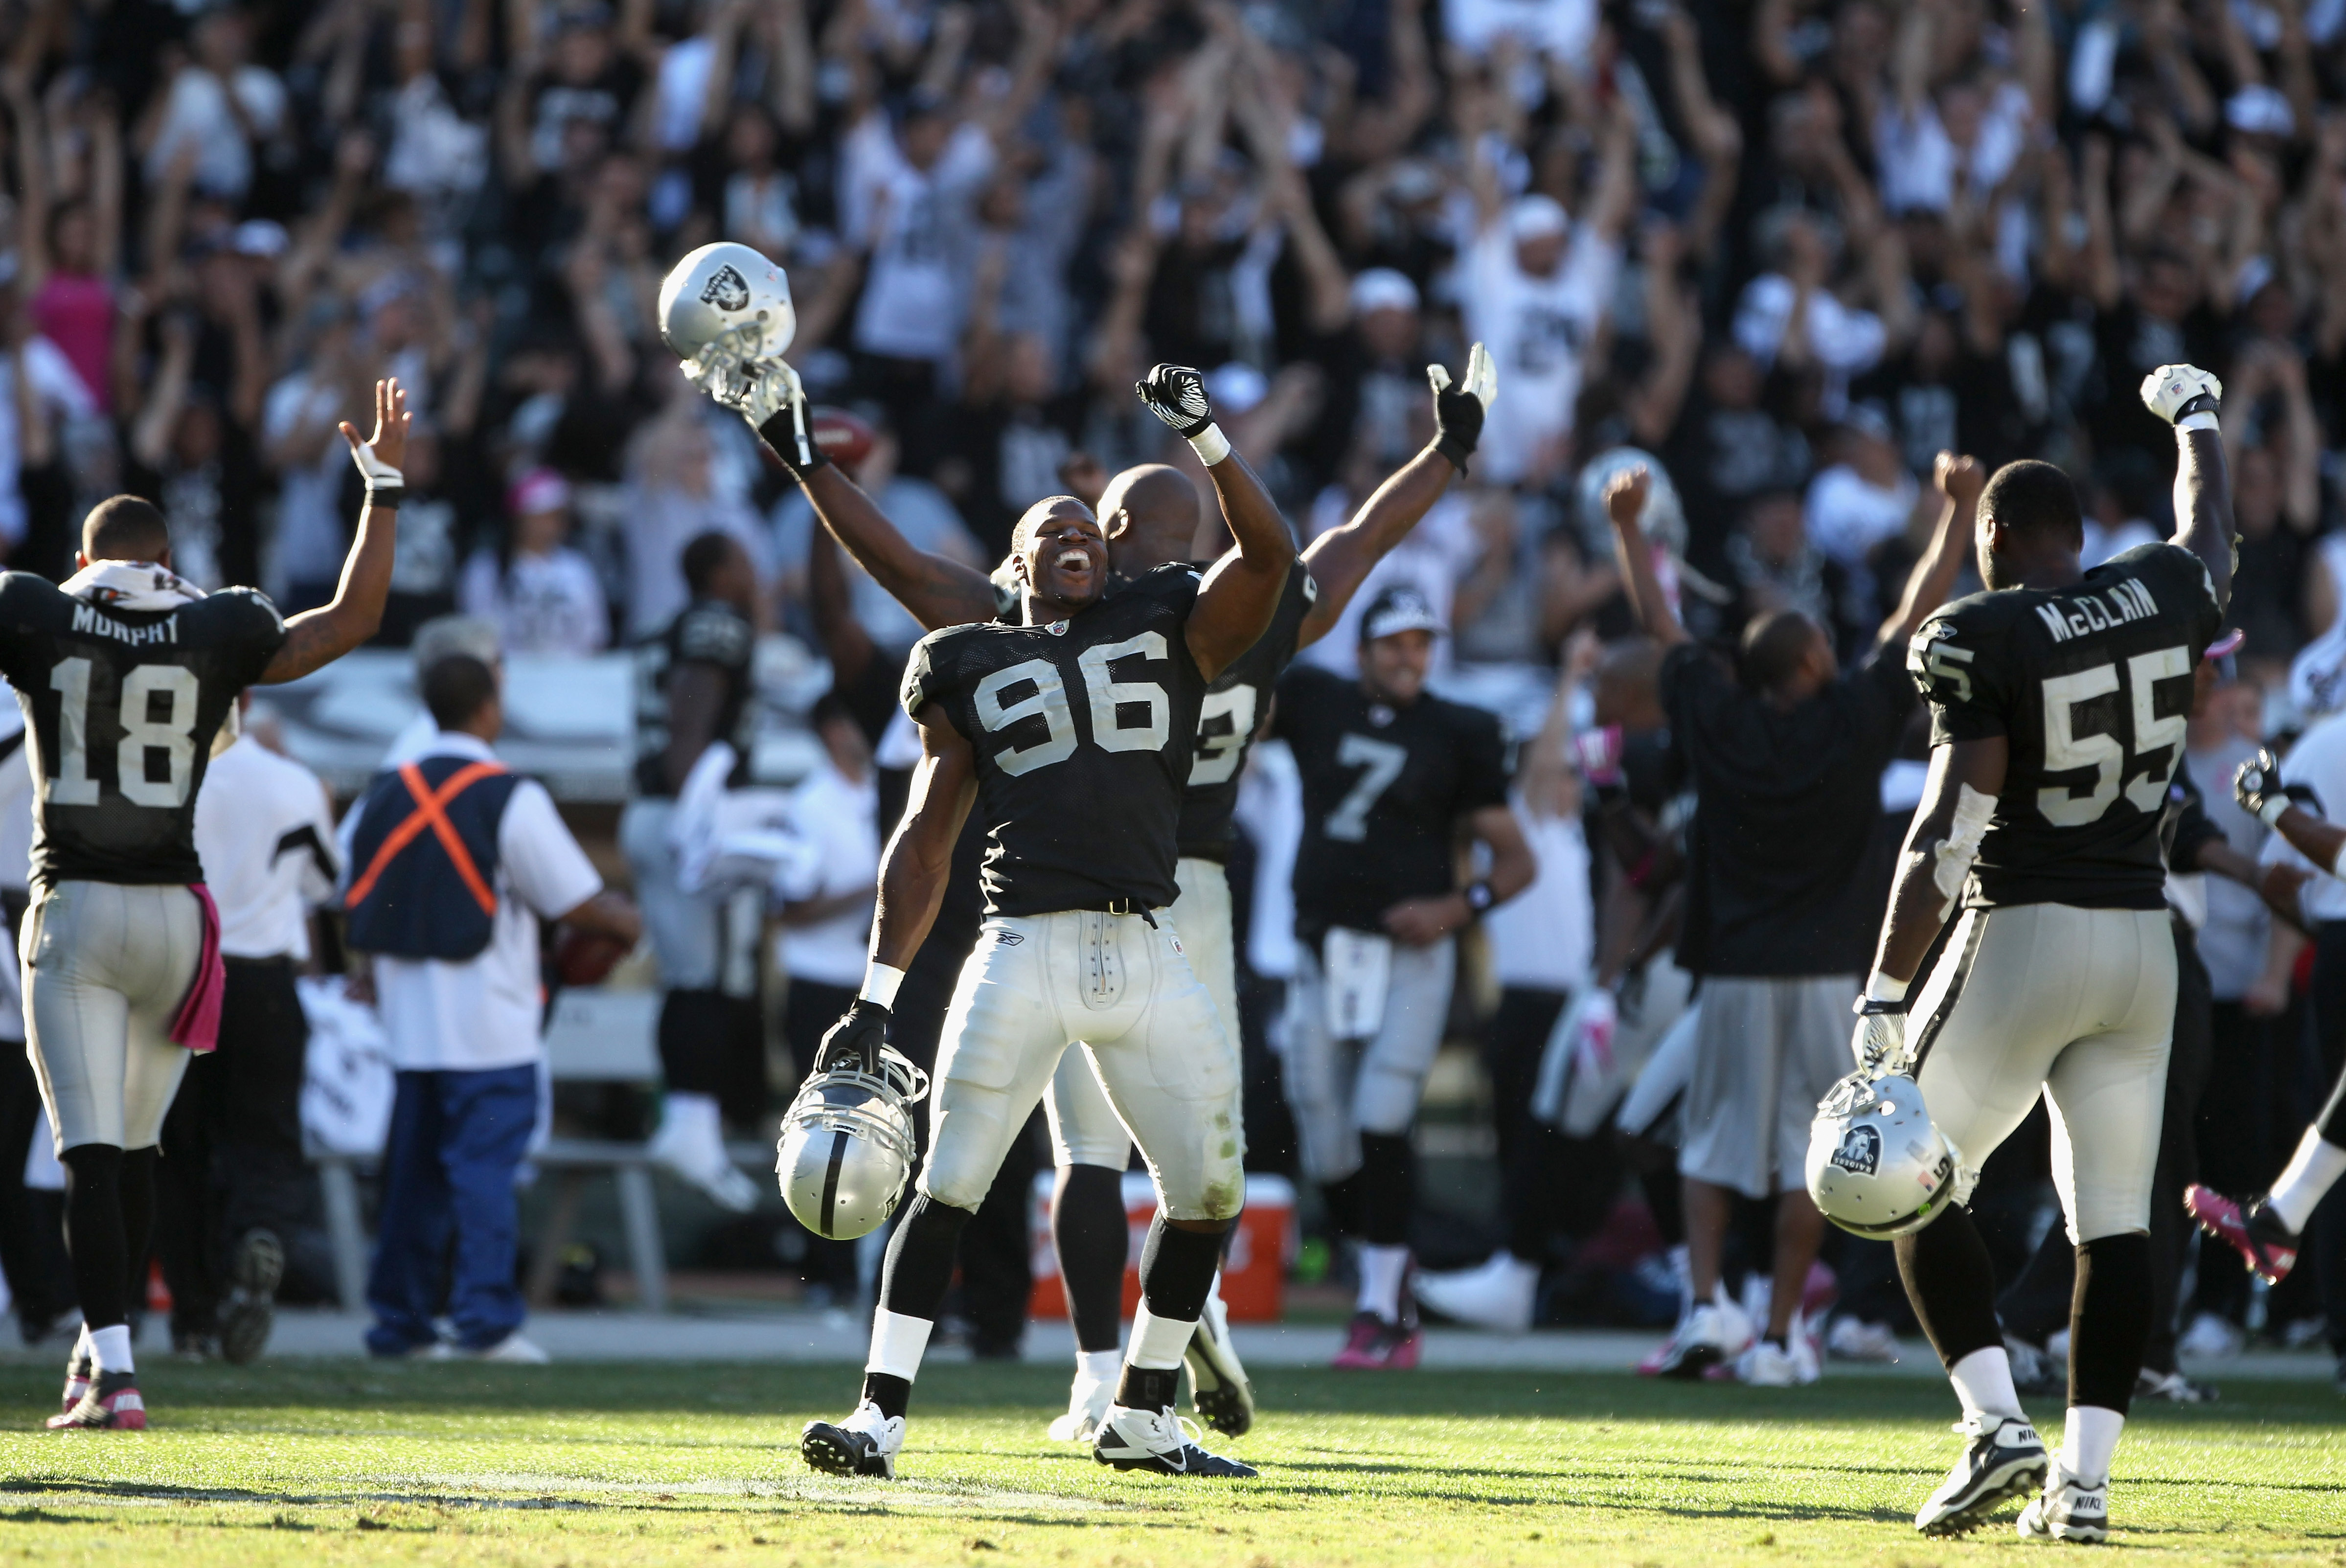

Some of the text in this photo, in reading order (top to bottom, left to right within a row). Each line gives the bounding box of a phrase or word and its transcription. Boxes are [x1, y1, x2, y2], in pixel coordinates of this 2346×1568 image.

[71, 604, 179, 647] MURPHY
[2035, 578, 2160, 643] McCLAIN
[45, 656, 199, 808] 18
[974, 630, 1170, 777] 96
[2037, 645, 2191, 827] 55
[1322, 732, 1408, 843] 7
[1834, 1157, 1872, 1173] RAIDERS
